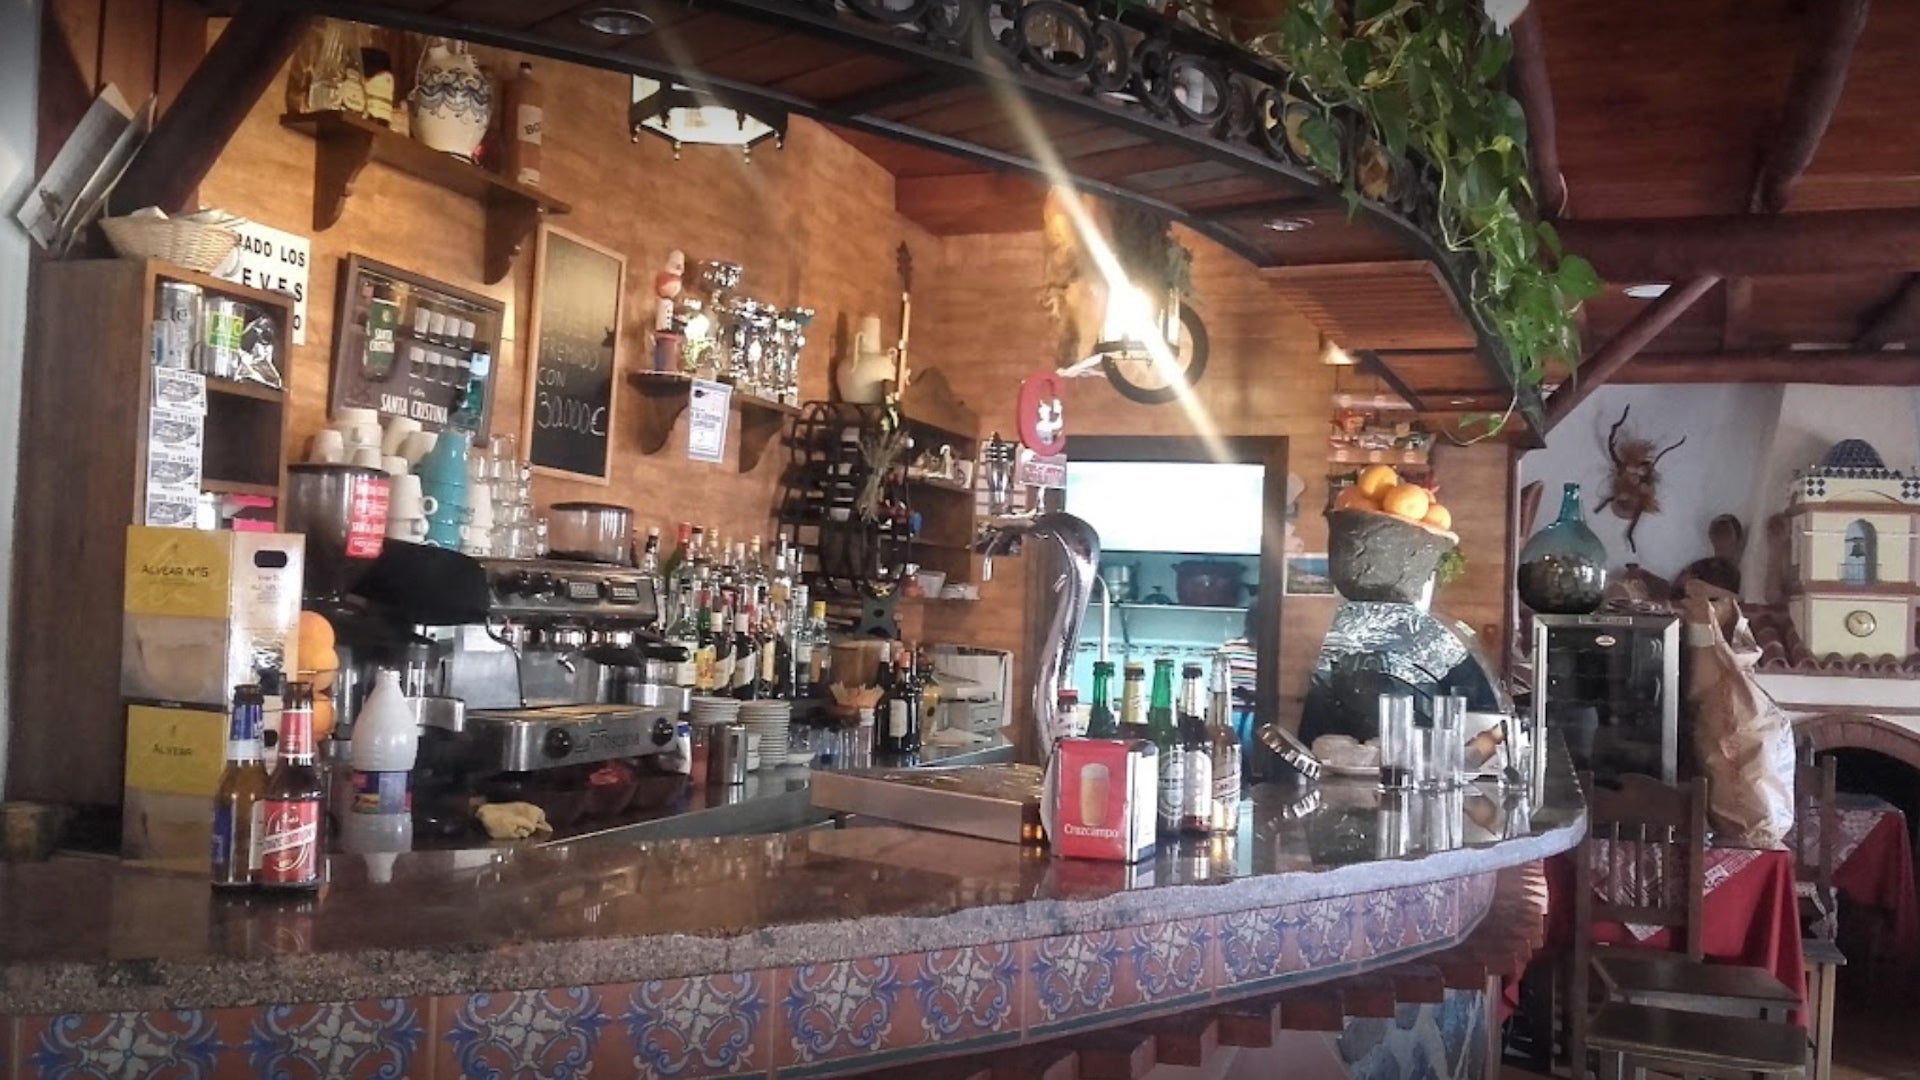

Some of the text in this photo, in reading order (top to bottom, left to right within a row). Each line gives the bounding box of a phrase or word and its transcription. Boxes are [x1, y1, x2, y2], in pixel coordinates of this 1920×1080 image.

[280, 245, 306, 268] LOS
[537, 366, 567, 388] CON
[380, 393, 449, 425] SANTA CRISTINA
[141, 562, 184, 577] ALVEAR
[1063, 822, 1119, 840] Cruzcampo
